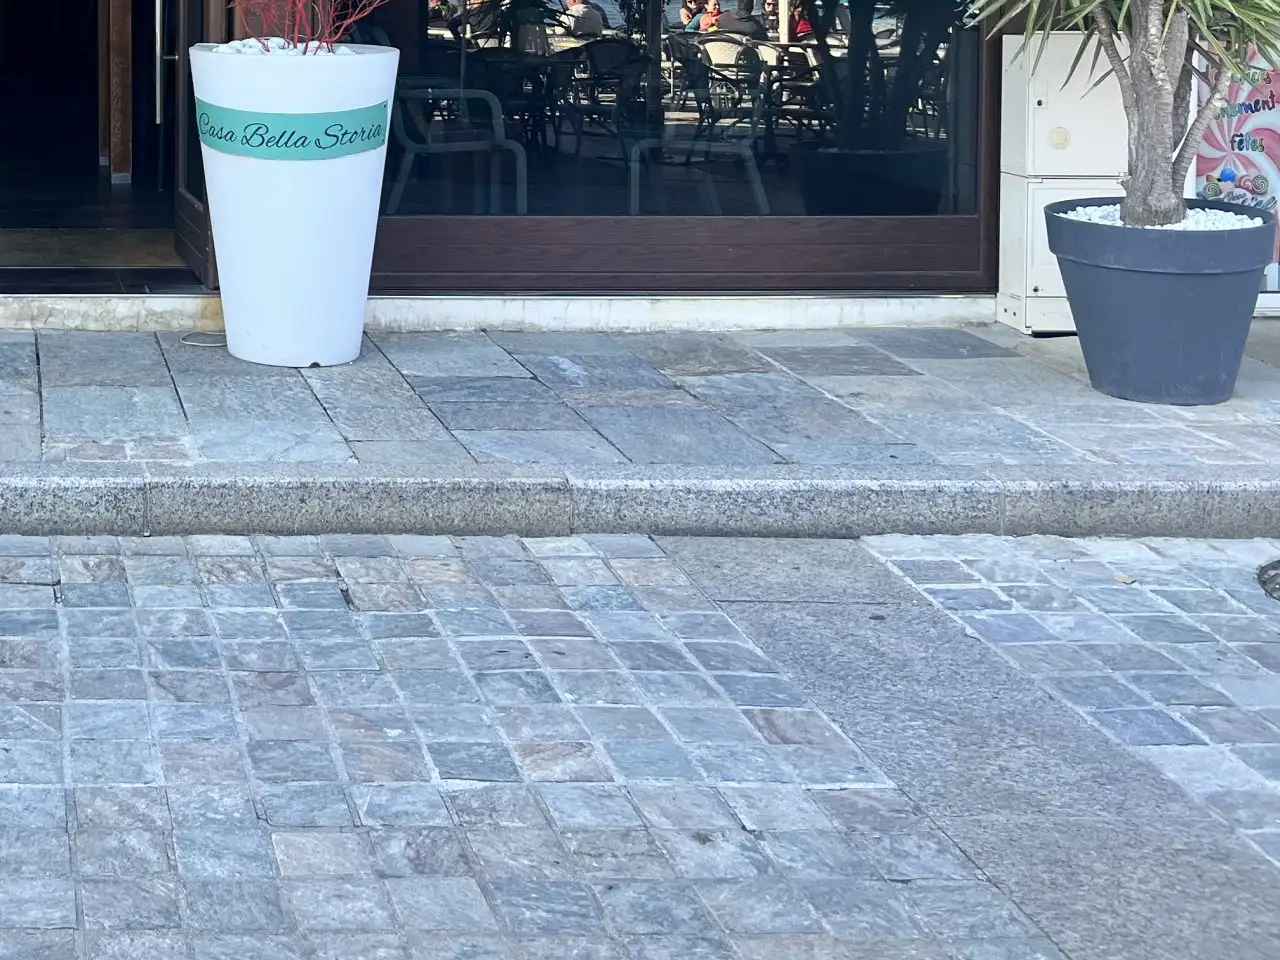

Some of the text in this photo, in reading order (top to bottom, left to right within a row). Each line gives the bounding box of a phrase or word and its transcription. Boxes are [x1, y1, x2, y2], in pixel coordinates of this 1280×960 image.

[199, 113, 384, 149] Casa Bella Storia
